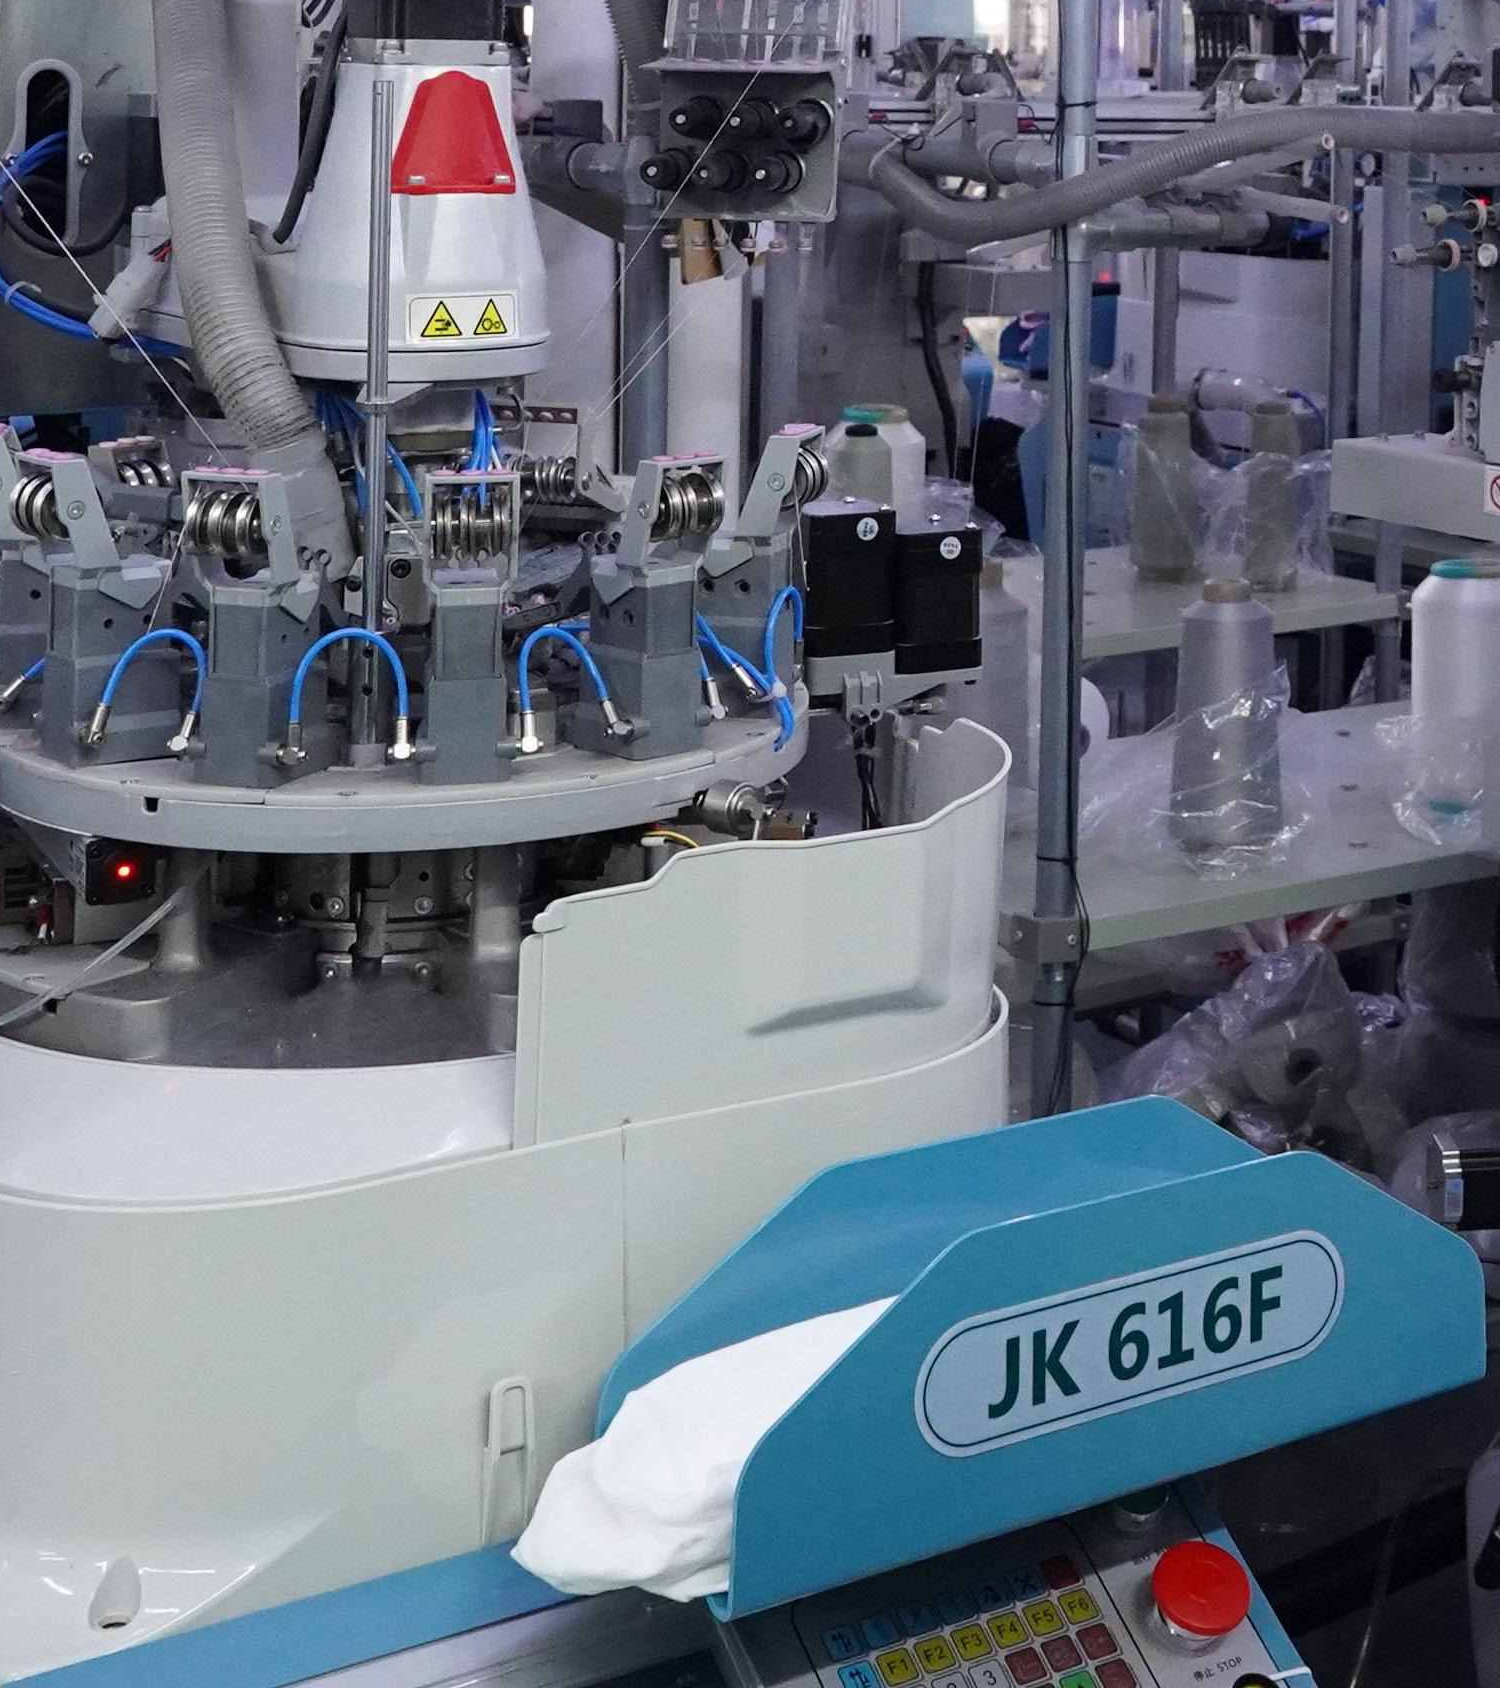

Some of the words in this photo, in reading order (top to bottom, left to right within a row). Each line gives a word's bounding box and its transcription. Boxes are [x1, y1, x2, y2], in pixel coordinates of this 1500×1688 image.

[988, 1319, 1081, 1419] JK
[1108, 1265, 1282, 1381] 616F
[886, 1658, 909, 1676] F1
[923, 1646, 946, 1664] F2
[960, 1633, 983, 1651] F3
[996, 1622, 1018, 1639] F4
[1032, 1609, 1054, 1627] F5
[1067, 1598, 1089, 1616] F6
[983, 1670, 997, 1687] 3
[1193, 1665, 1213, 1682] 停止
[1217, 1656, 1242, 1673] STOP
